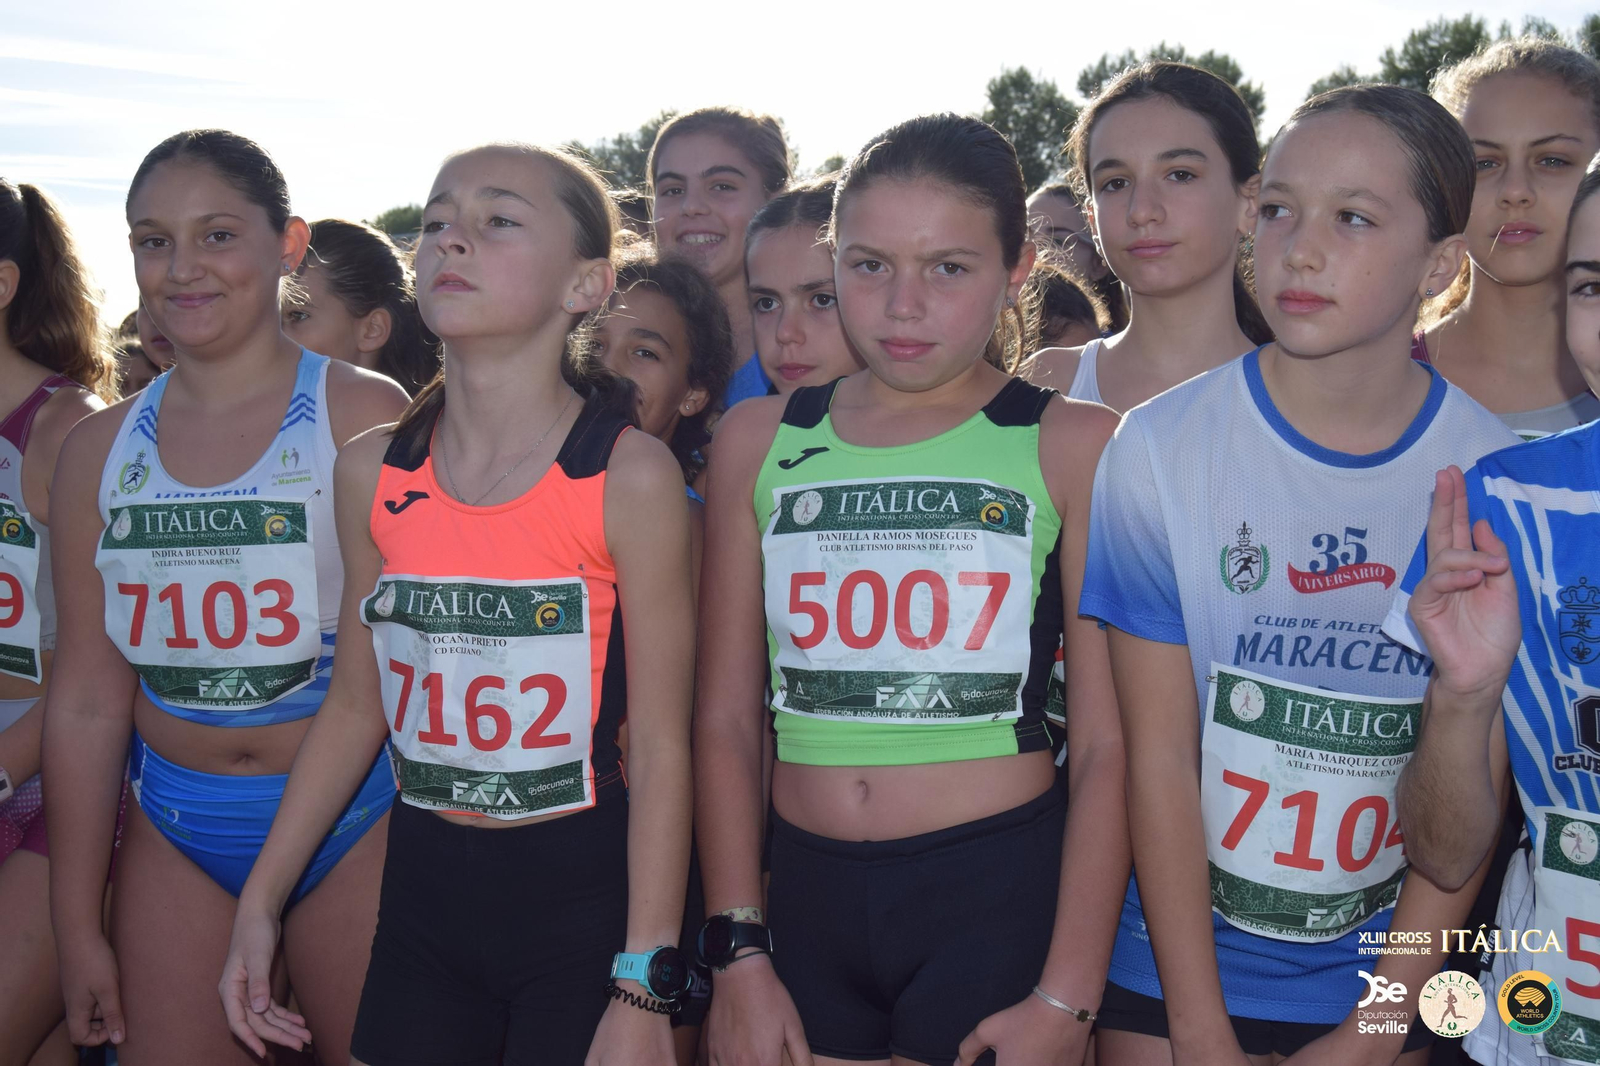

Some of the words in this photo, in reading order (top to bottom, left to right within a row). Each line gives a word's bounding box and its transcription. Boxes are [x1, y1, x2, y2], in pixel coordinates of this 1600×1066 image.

[838, 485, 960, 514] ITÁLICA
[144, 506, 247, 533] ITÁLICA
[817, 532, 870, 541] DANIELLA
[872, 532, 912, 541] RAMOS
[914, 532, 977, 541] MOSEGUES
[151, 550, 183, 558] INDIRA
[185, 548, 217, 557] BUENO
[218, 547, 241, 556] RUIZ
[819, 544, 842, 552] CLUB
[843, 543, 894, 552] ATLETISMO
[895, 543, 927, 551] BRISAS
[929, 543, 948, 551] DEL
[949, 543, 973, 551] PASO
[1309, 526, 1368, 576] 35
[198, 558, 240, 566] MARACENA
[407, 585, 515, 620] ITÁLICA
[789, 569, 1011, 651] 5007
[117, 578, 301, 650] 7103
[482, 619, 515, 627] COUNTRY
[1254, 615, 1297, 628] CLUB
[1301, 618, 1320, 629] DE
[432, 633, 469, 645] OCAÑA
[471, 636, 507, 647] PRIETO
[434, 647, 447, 655] CD
[389, 658, 571, 752] 7162
[1283, 699, 1414, 738] ITÁLICA
[1282, 726, 1349, 743] INTERNATIONAL
[1274, 743, 1315, 760] MARIA
[1318, 753, 1379, 767] MARQUEZ
[1381, 756, 1408, 767] COBO
[1286, 760, 1344, 776] ATLETISMO
[1346, 769, 1396, 778] MARACENA
[537, 777, 574, 793] docunova
[1230, 914, 1278, 934] FEDERACIÓN
[1565, 917, 1600, 1000] 5
